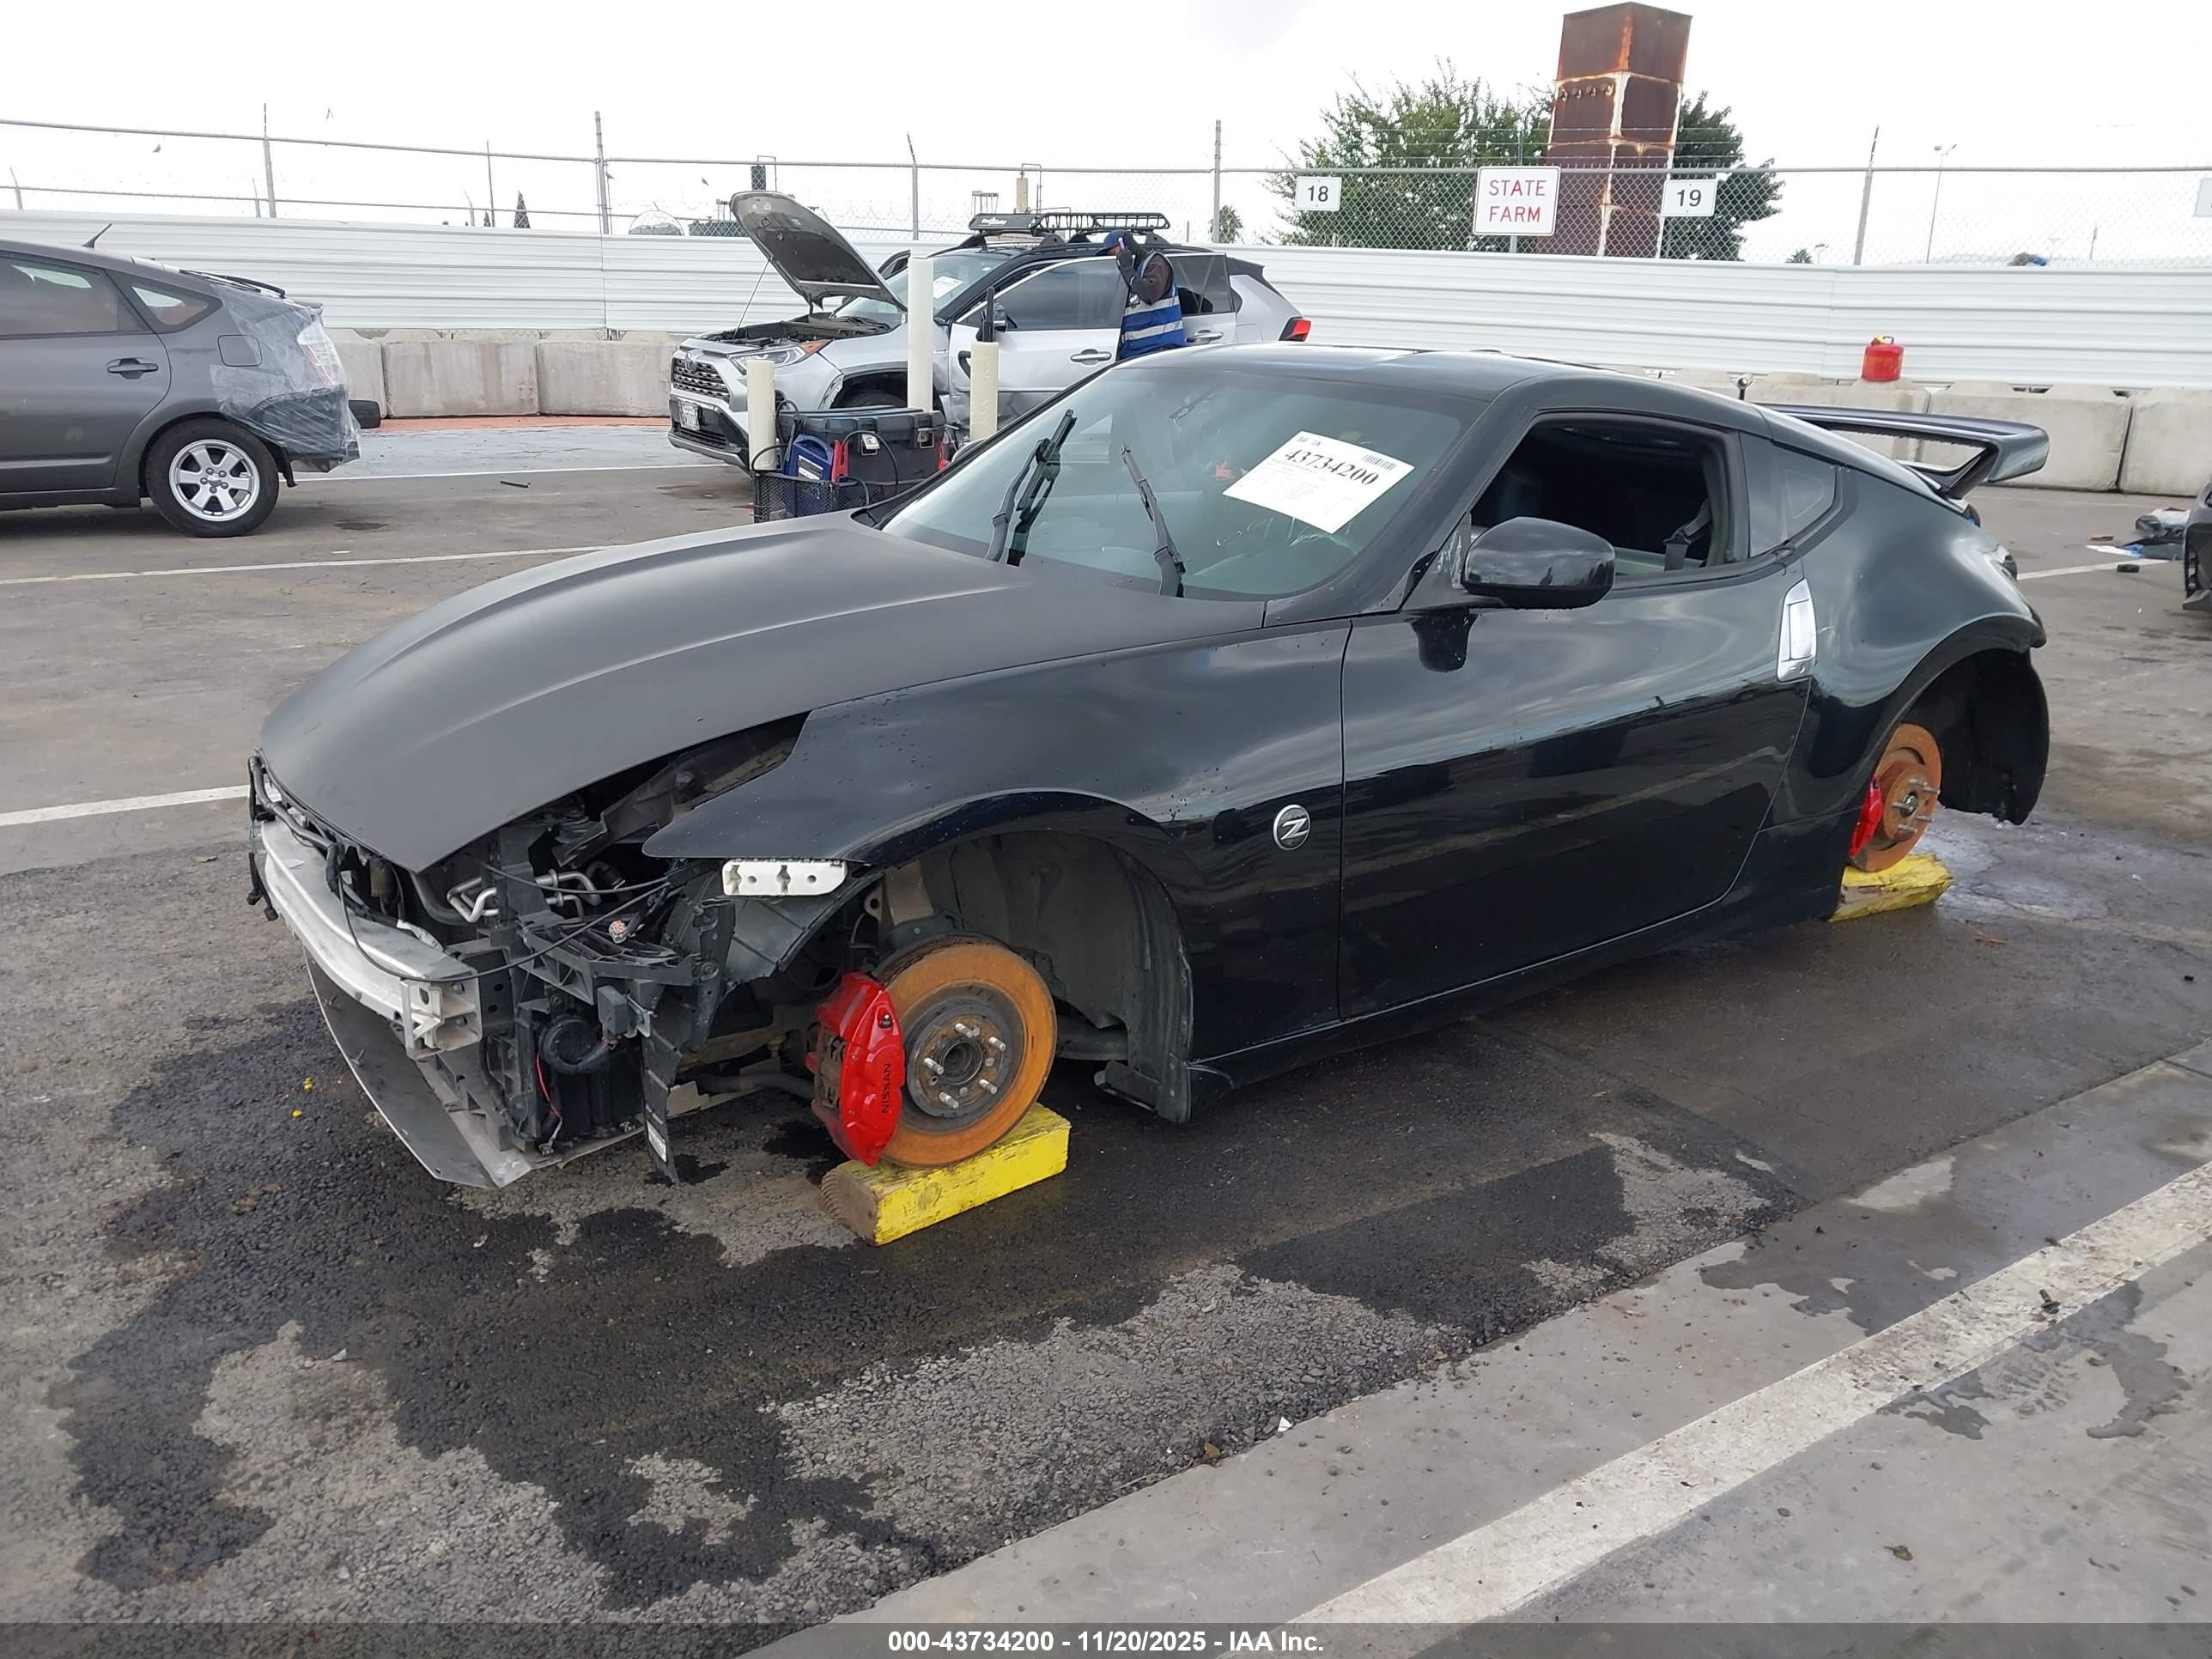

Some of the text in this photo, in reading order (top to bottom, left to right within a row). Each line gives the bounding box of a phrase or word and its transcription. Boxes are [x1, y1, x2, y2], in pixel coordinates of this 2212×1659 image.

[1308, 185, 1328, 202] 18
[1489, 179, 1547, 197] STATE
[1677, 189, 1701, 207] 19
[1489, 206, 1540, 222] FARM
[1285, 449, 1379, 485] 43734200
[881, 1063, 891, 1114] NISSAN
